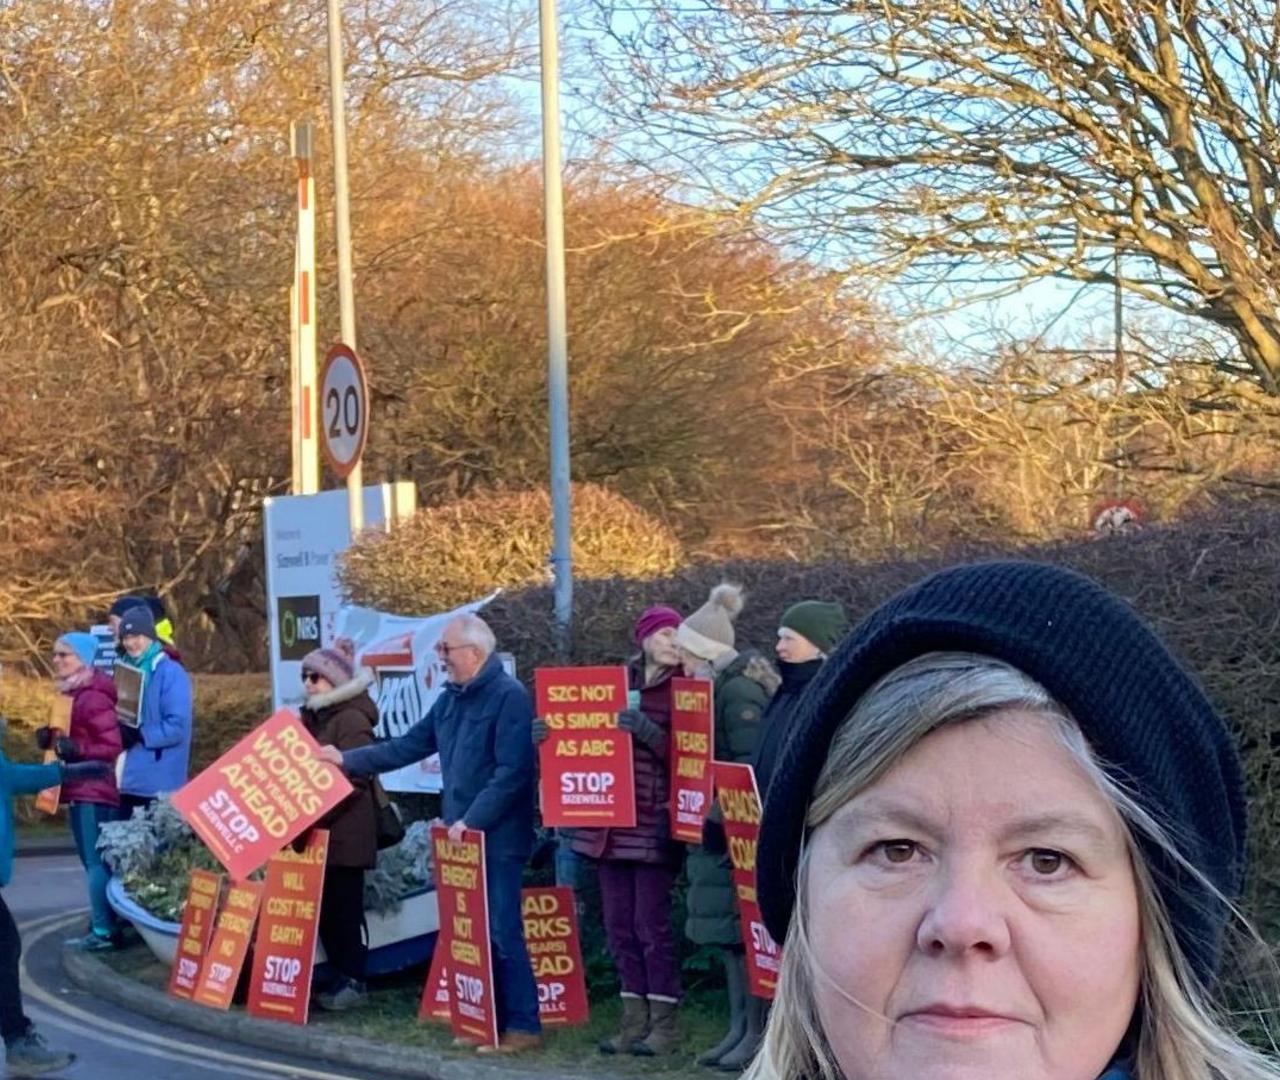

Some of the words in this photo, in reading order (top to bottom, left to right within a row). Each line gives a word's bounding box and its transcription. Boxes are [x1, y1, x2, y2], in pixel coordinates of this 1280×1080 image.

[327, 385, 359, 438] 20
[297, 616, 318, 639] NRS
[547, 685, 579, 702] SZC
[582, 685, 615, 702] NOT
[567, 712, 618, 730] SIMPL
[556, 740, 578, 756] AS
[580, 740, 615, 756] ABC
[675, 731, 708, 754] YEARS
[277, 725, 333, 790] ROAD
[253, 732, 323, 815] WORKS
[561, 771, 615, 792] STOP
[220, 763, 288, 838] AHEAD
[678, 789, 704, 812] STOP
[209, 789, 259, 843] STOP
[267, 897, 294, 917] COST
[522, 895, 558, 915] AD
[453, 915, 472, 940] NOT
[523, 917, 572, 939] RKS
[750, 921, 777, 955] STO
[264, 955, 301, 983] STOP
[531, 955, 574, 977] EAD
[455, 973, 484, 1005] STOP
[537, 983, 565, 1002] OP
